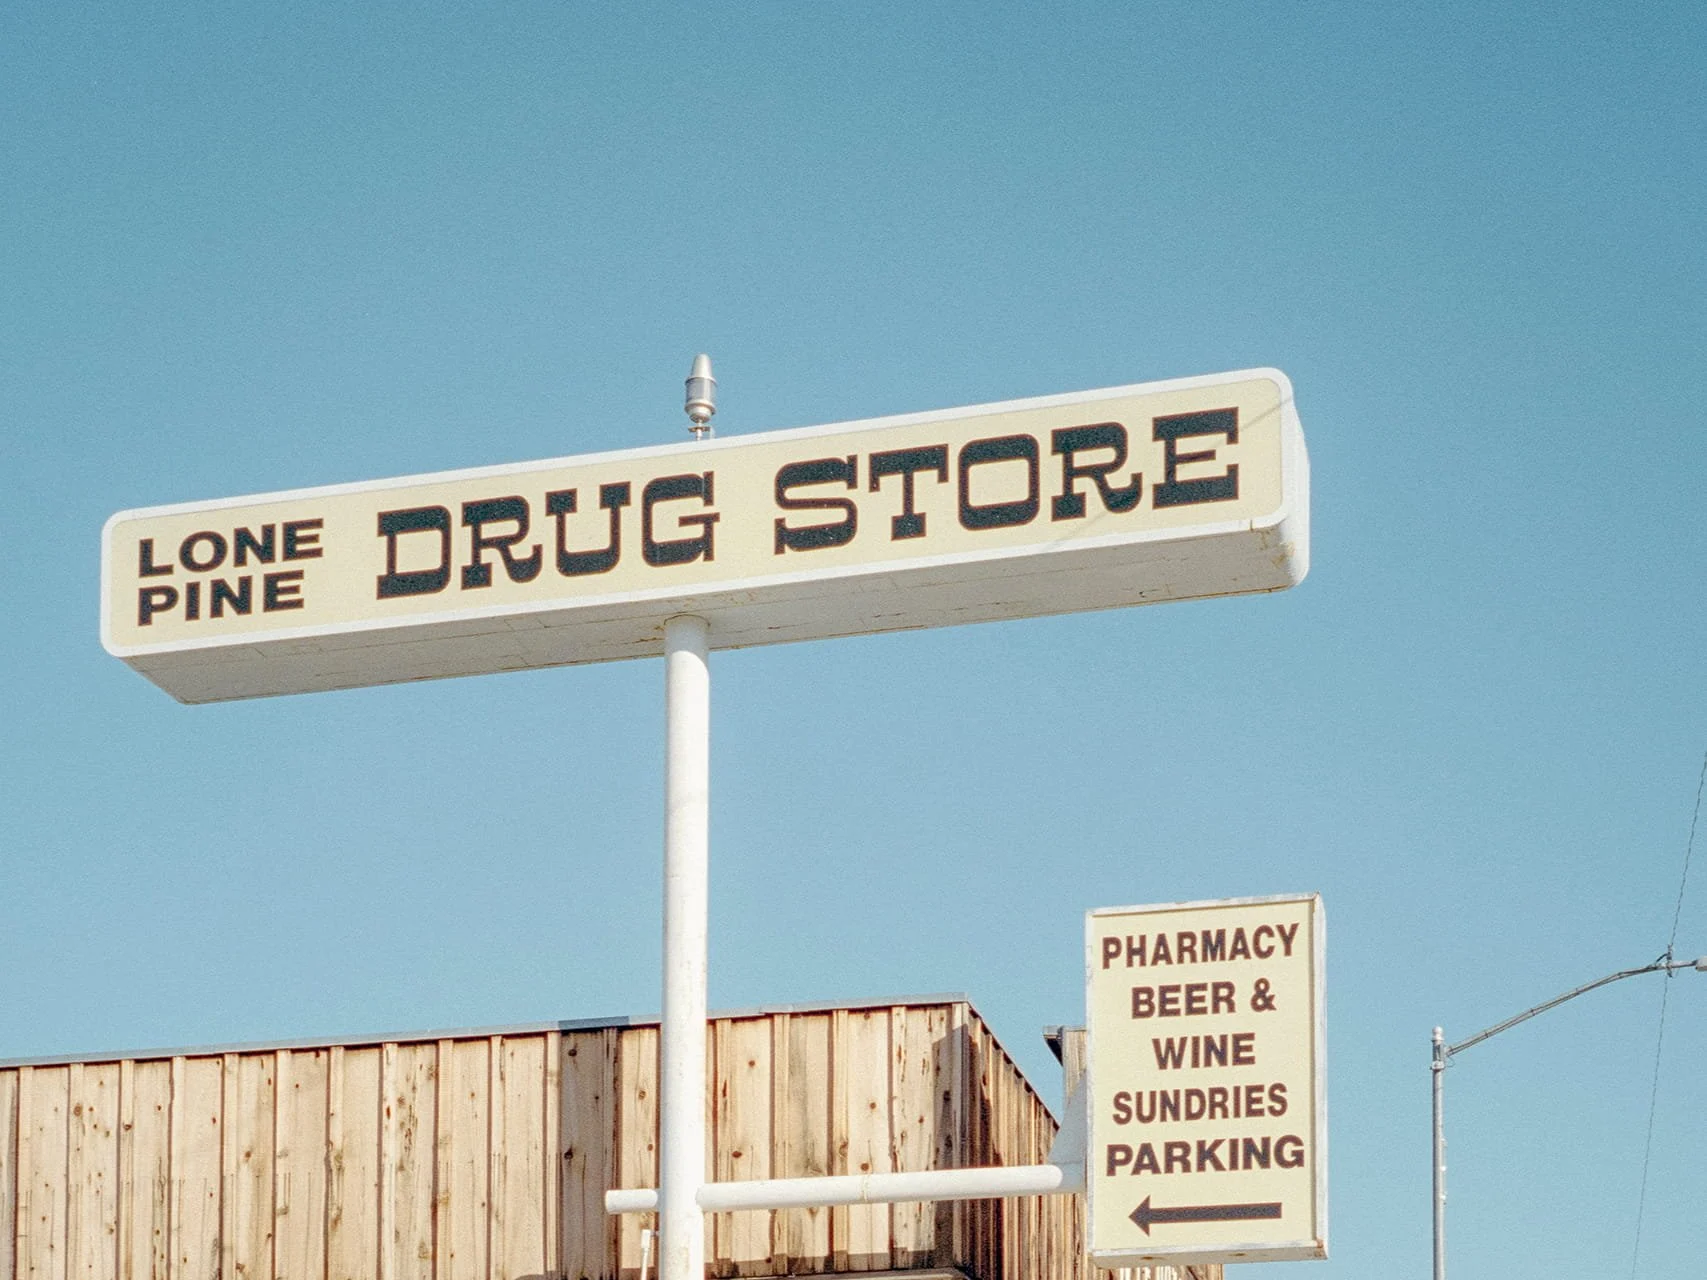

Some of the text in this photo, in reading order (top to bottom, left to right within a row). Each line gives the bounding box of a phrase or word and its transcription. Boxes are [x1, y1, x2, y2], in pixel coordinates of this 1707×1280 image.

[376, 406, 1240, 601] DRUG STORE
[138, 517, 325, 578] LONE
[138, 569, 305, 627] PINE
[1102, 922, 1300, 970] PHARMACY
[1131, 977, 1277, 1020] BEER &
[1152, 1032, 1256, 1071] WINE
[1112, 1082, 1288, 1126] SUNDRIES
[1106, 1134, 1305, 1177] PARKING
